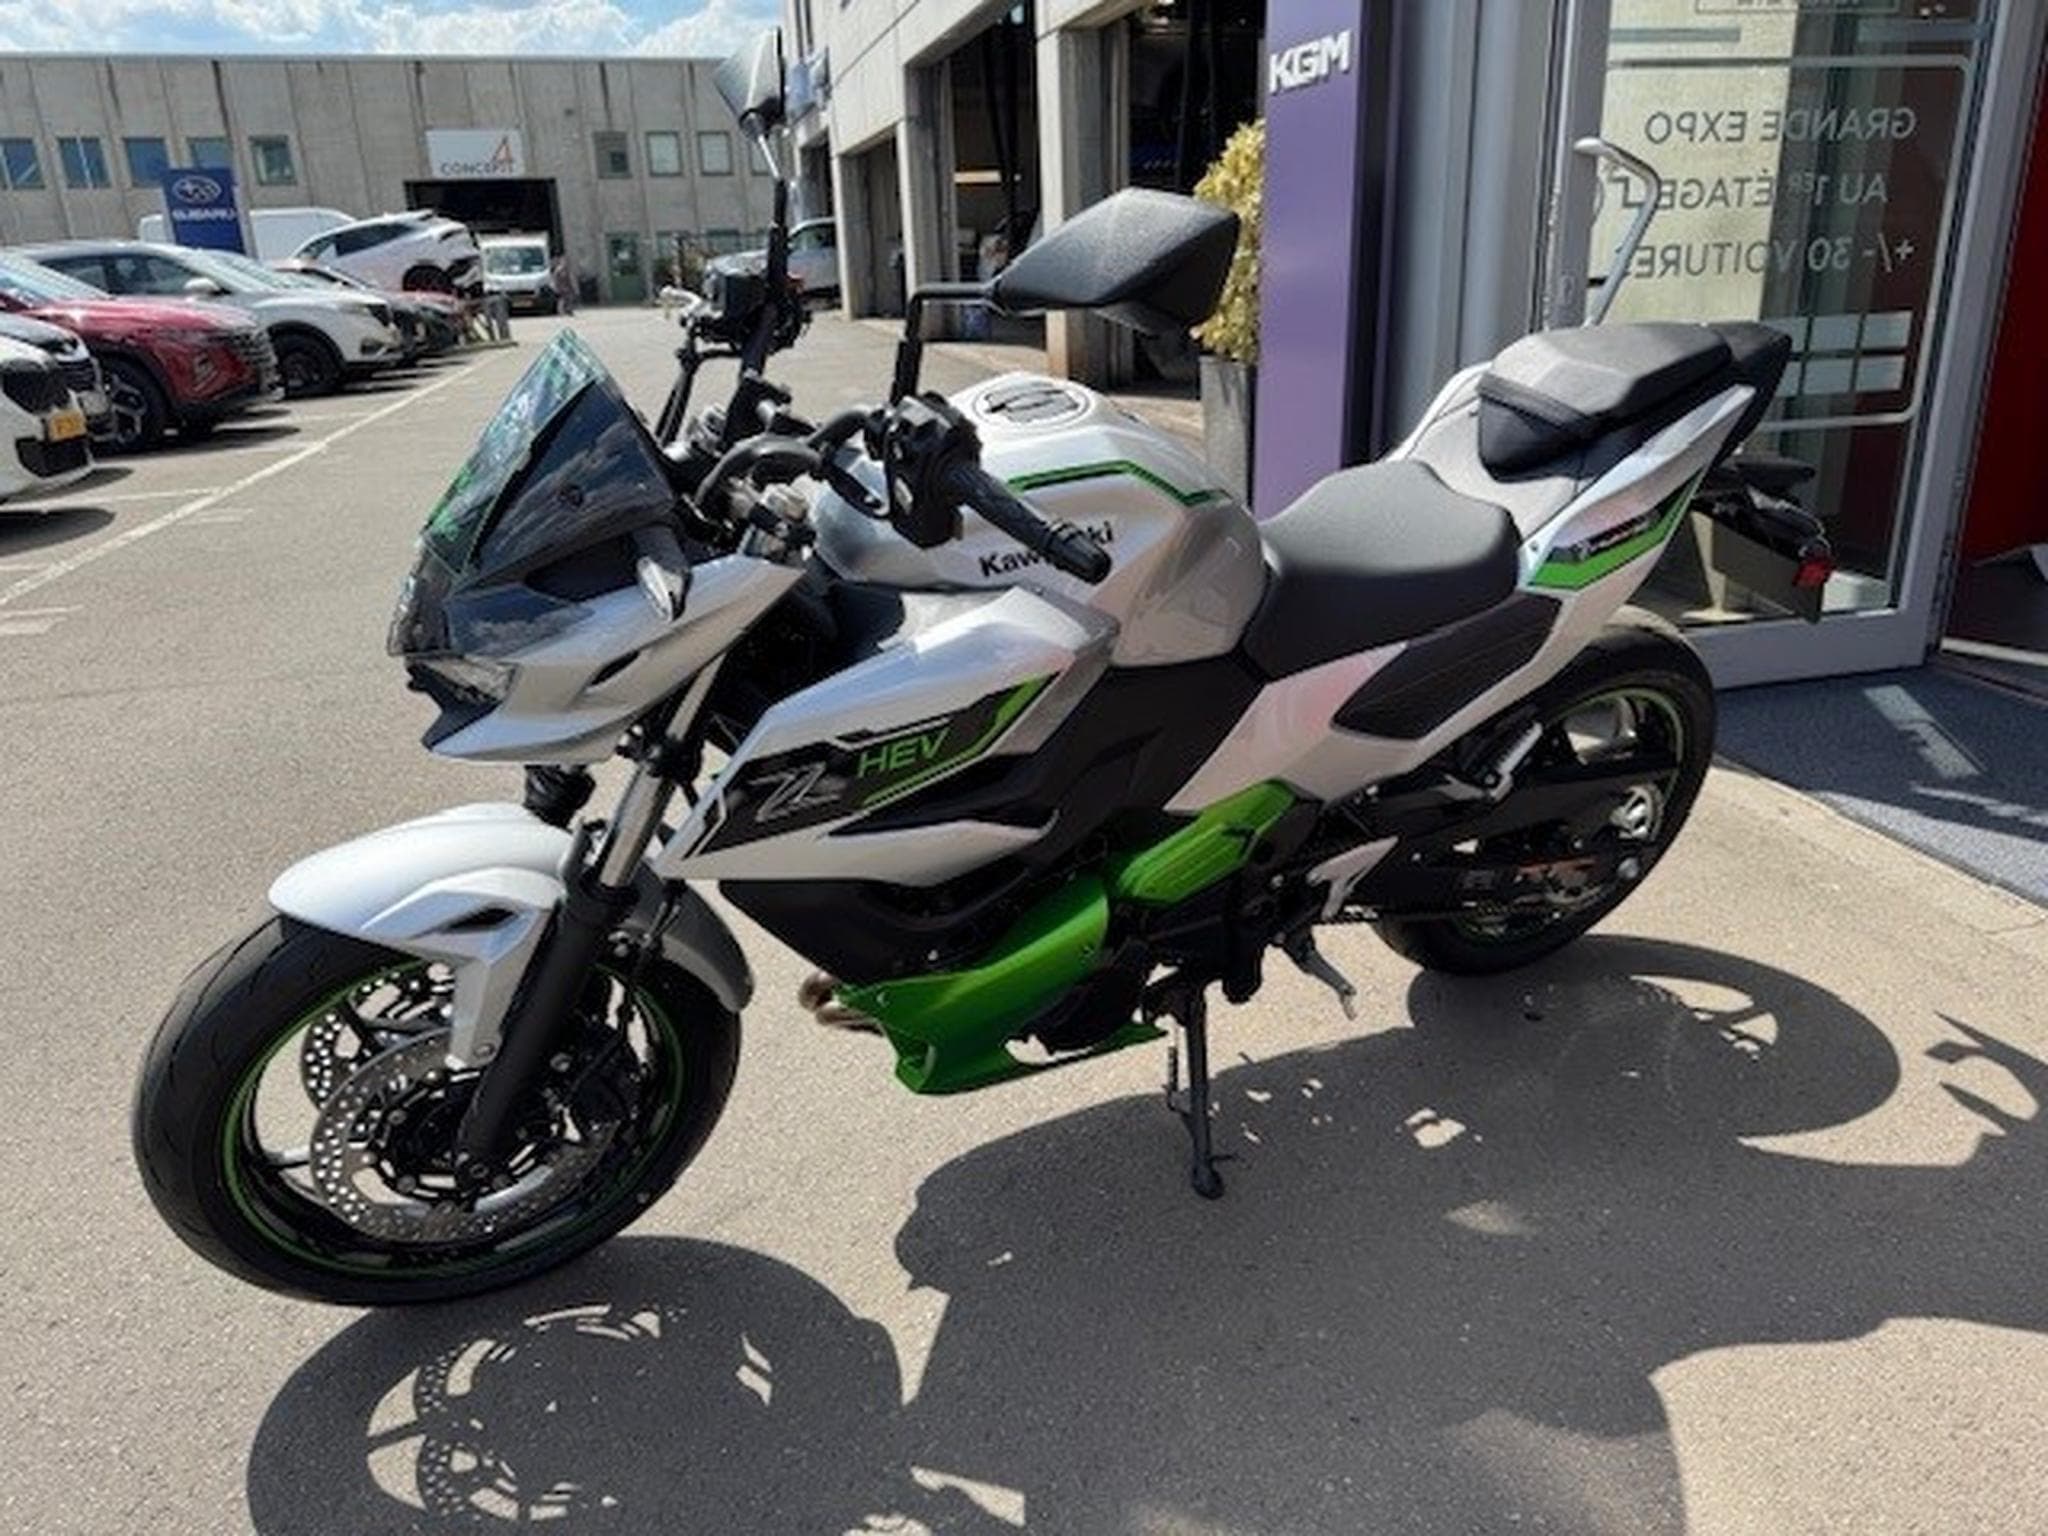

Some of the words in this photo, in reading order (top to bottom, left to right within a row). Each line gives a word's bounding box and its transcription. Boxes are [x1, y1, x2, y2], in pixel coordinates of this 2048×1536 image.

[1269, 29, 1353, 95] KGM
[172, 208, 236, 221] SUBARU
[979, 519, 1113, 579] Kawki
[858, 728, 949, 778] HEV
